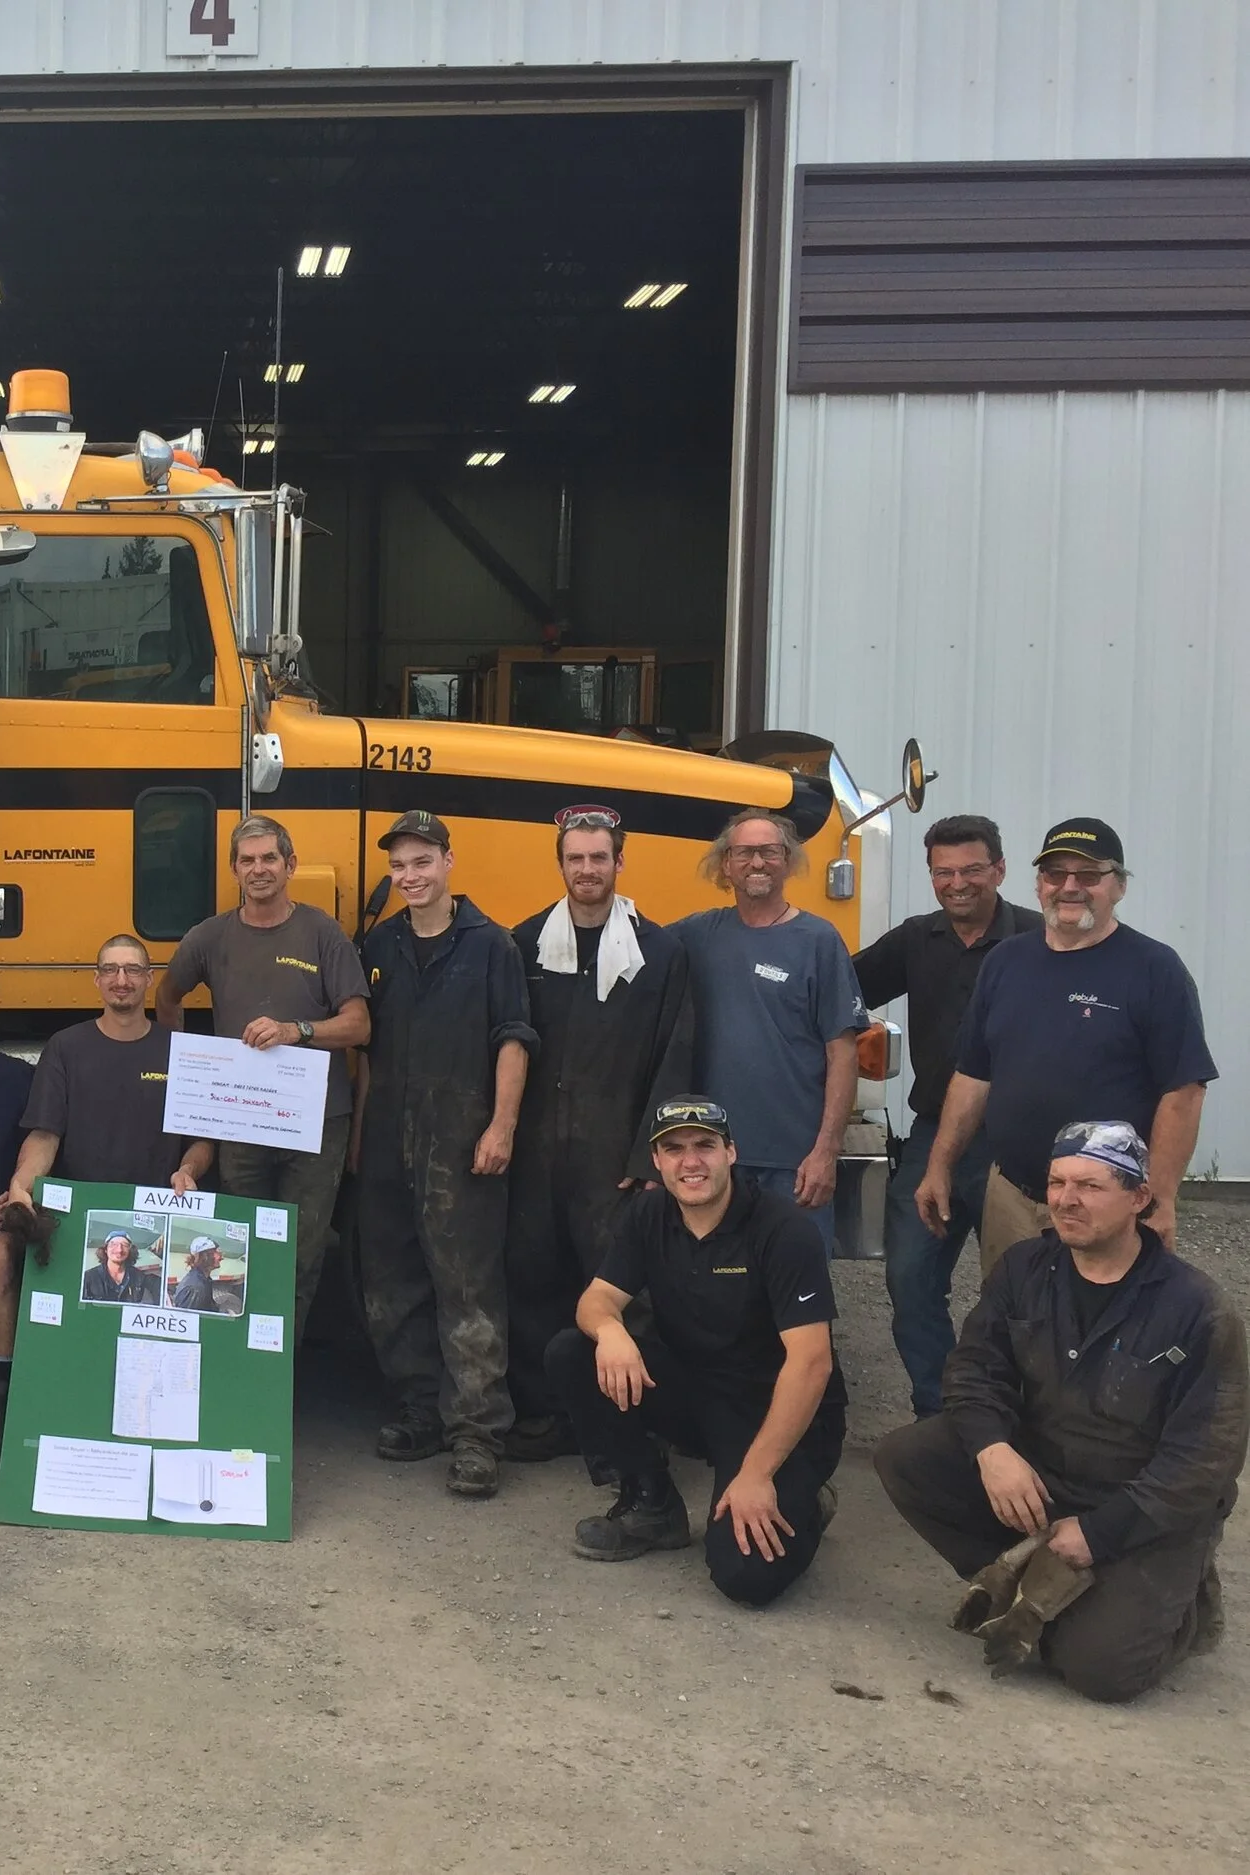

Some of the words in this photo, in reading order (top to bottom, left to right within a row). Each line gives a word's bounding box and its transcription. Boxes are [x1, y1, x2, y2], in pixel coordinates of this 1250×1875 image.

[190, 0, 236, 46] 4
[369, 743, 432, 771] 2143
[4, 848, 95, 860] LAFONTAINE
[276, 956, 318, 973] LAFONTAINE
[1068, 992, 1098, 1003] globule
[144, 1192, 204, 1210] AVANT
[131, 1313, 187, 1333] APRÈS
